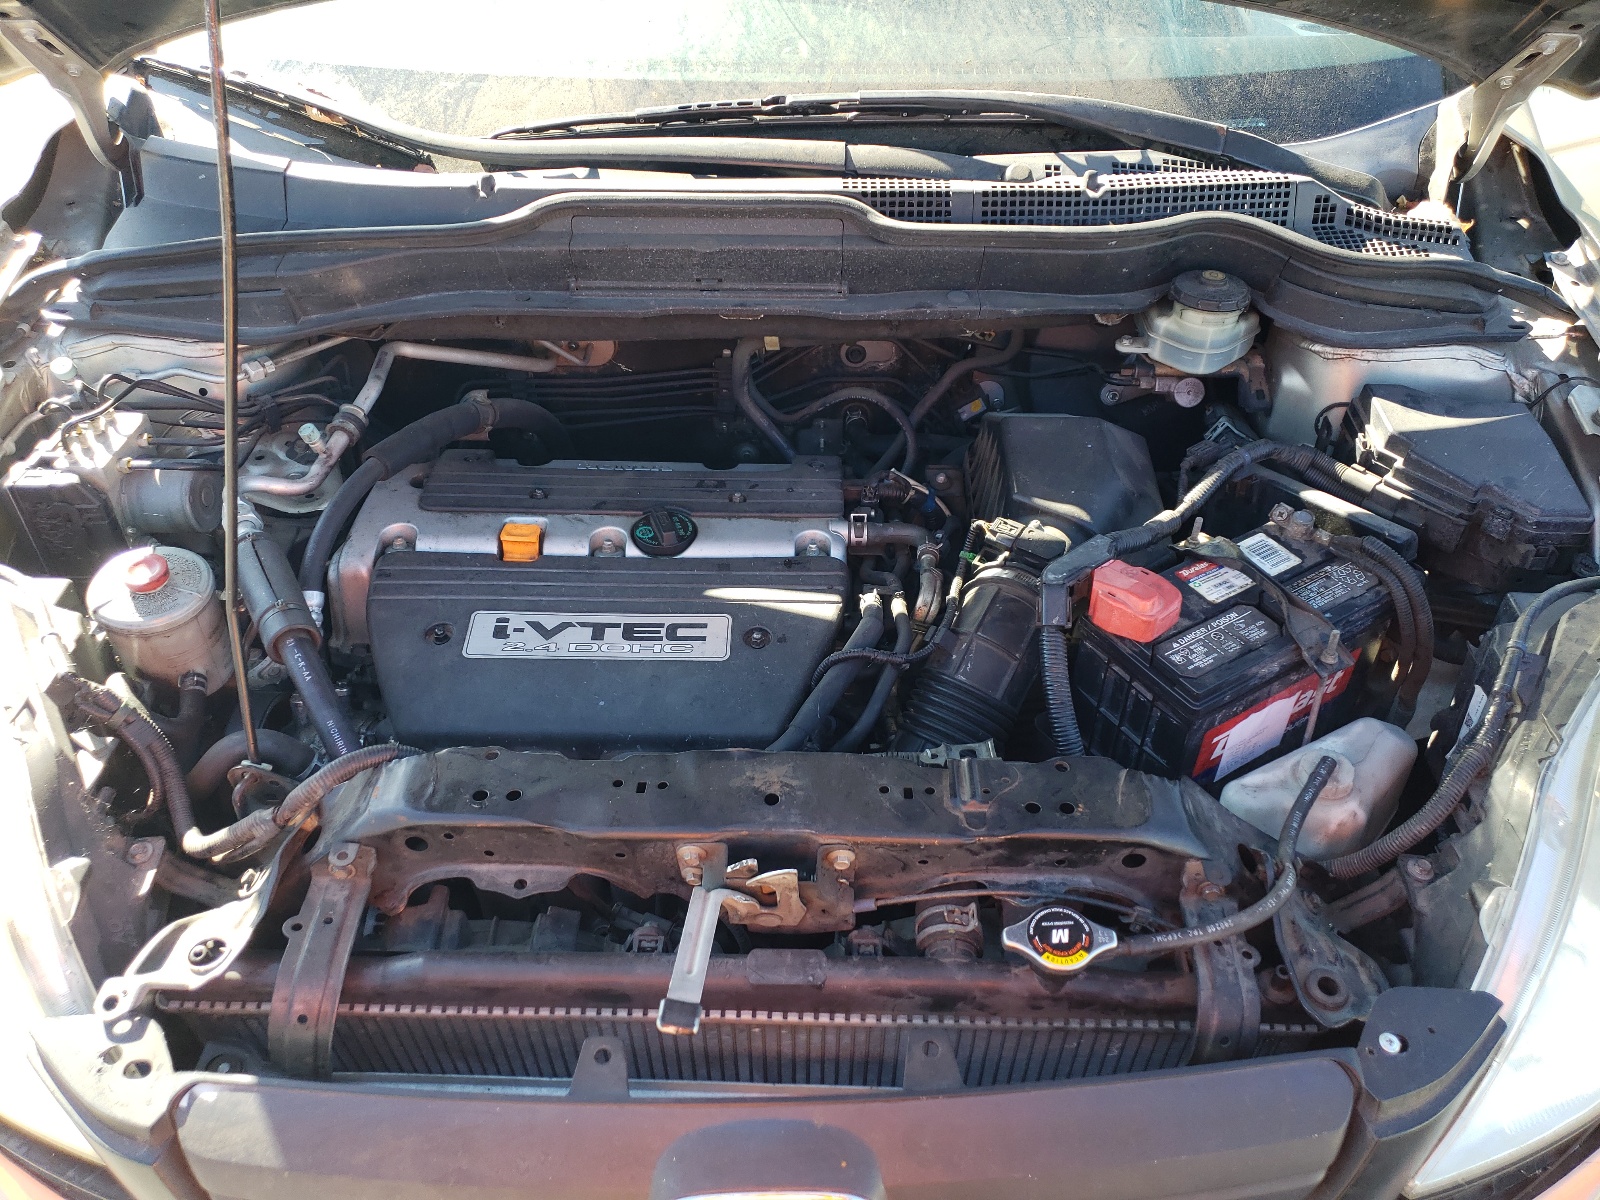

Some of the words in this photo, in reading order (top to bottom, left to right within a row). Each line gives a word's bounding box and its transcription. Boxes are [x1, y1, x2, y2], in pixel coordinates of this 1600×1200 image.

[492, 617, 708, 642] i-VTEC
[1179, 627, 1208, 645] DANGER
[1211, 611, 1239, 627] POISON
[501, 642, 557, 652] 2.4
[567, 642, 694, 653] DOHC
[326, 720, 348, 755] NICHIRIN
[1051, 928, 1069, 944] M
